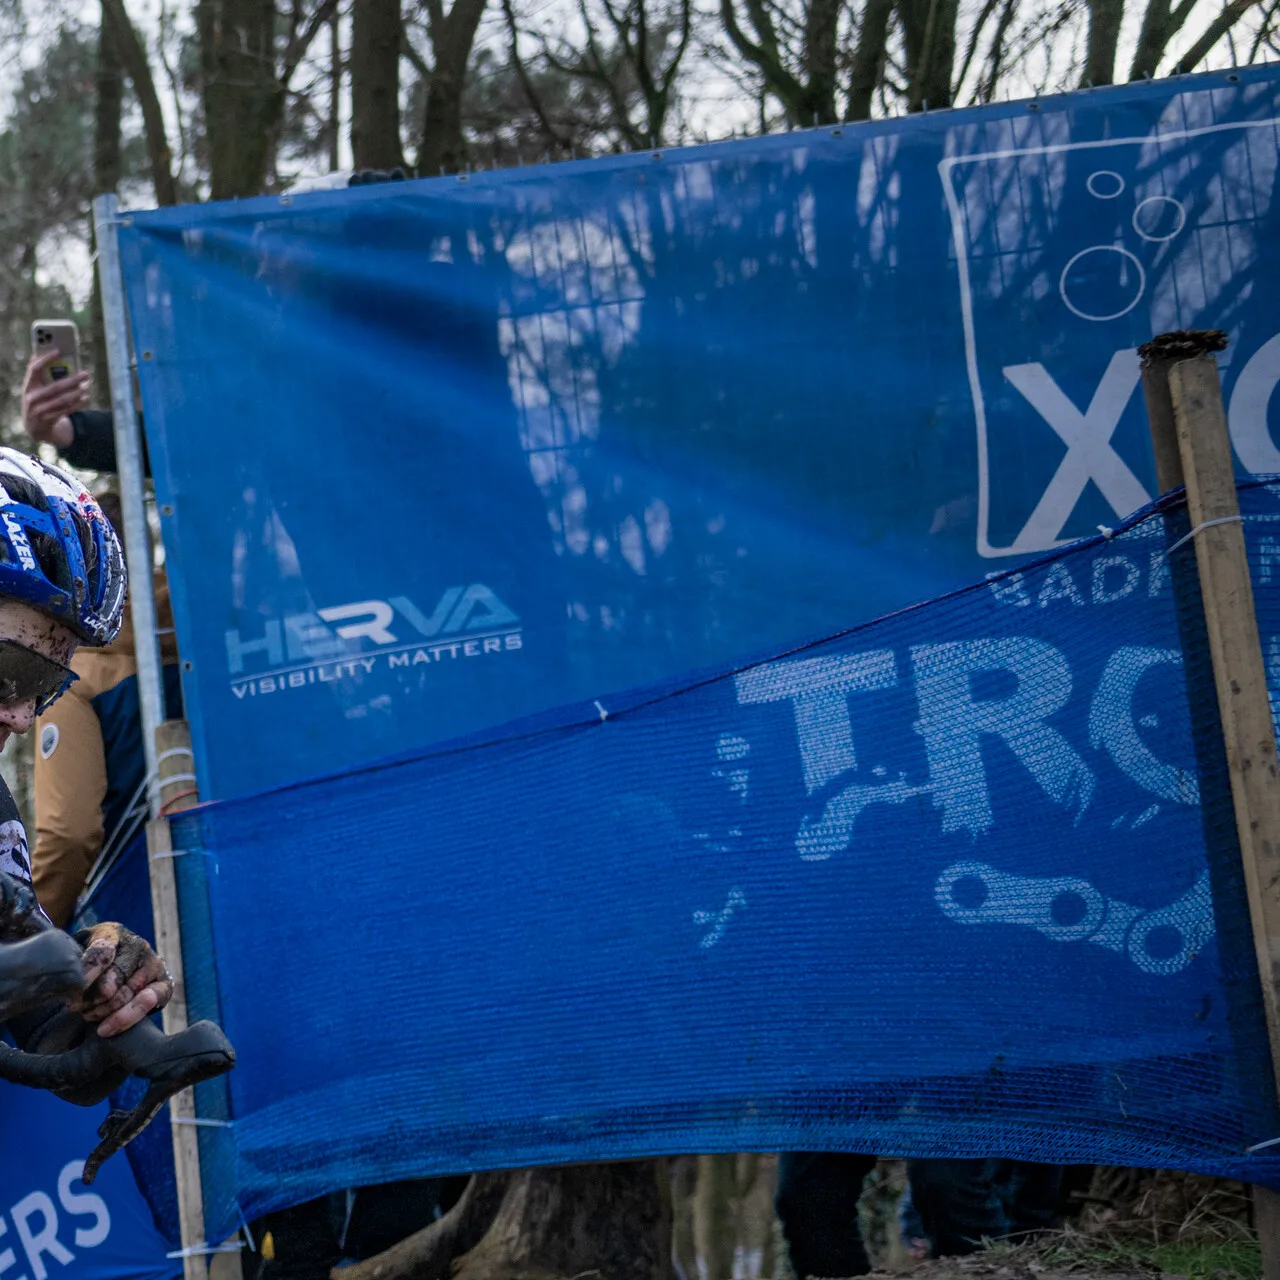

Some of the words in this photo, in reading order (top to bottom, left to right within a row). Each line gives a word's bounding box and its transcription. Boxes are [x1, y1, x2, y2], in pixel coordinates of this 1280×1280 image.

[0, 511, 37, 571] LAZER
[225, 584, 521, 674] HERVA
[231, 656, 376, 699] VISIBILITY
[389, 634, 522, 669] MATTERS
